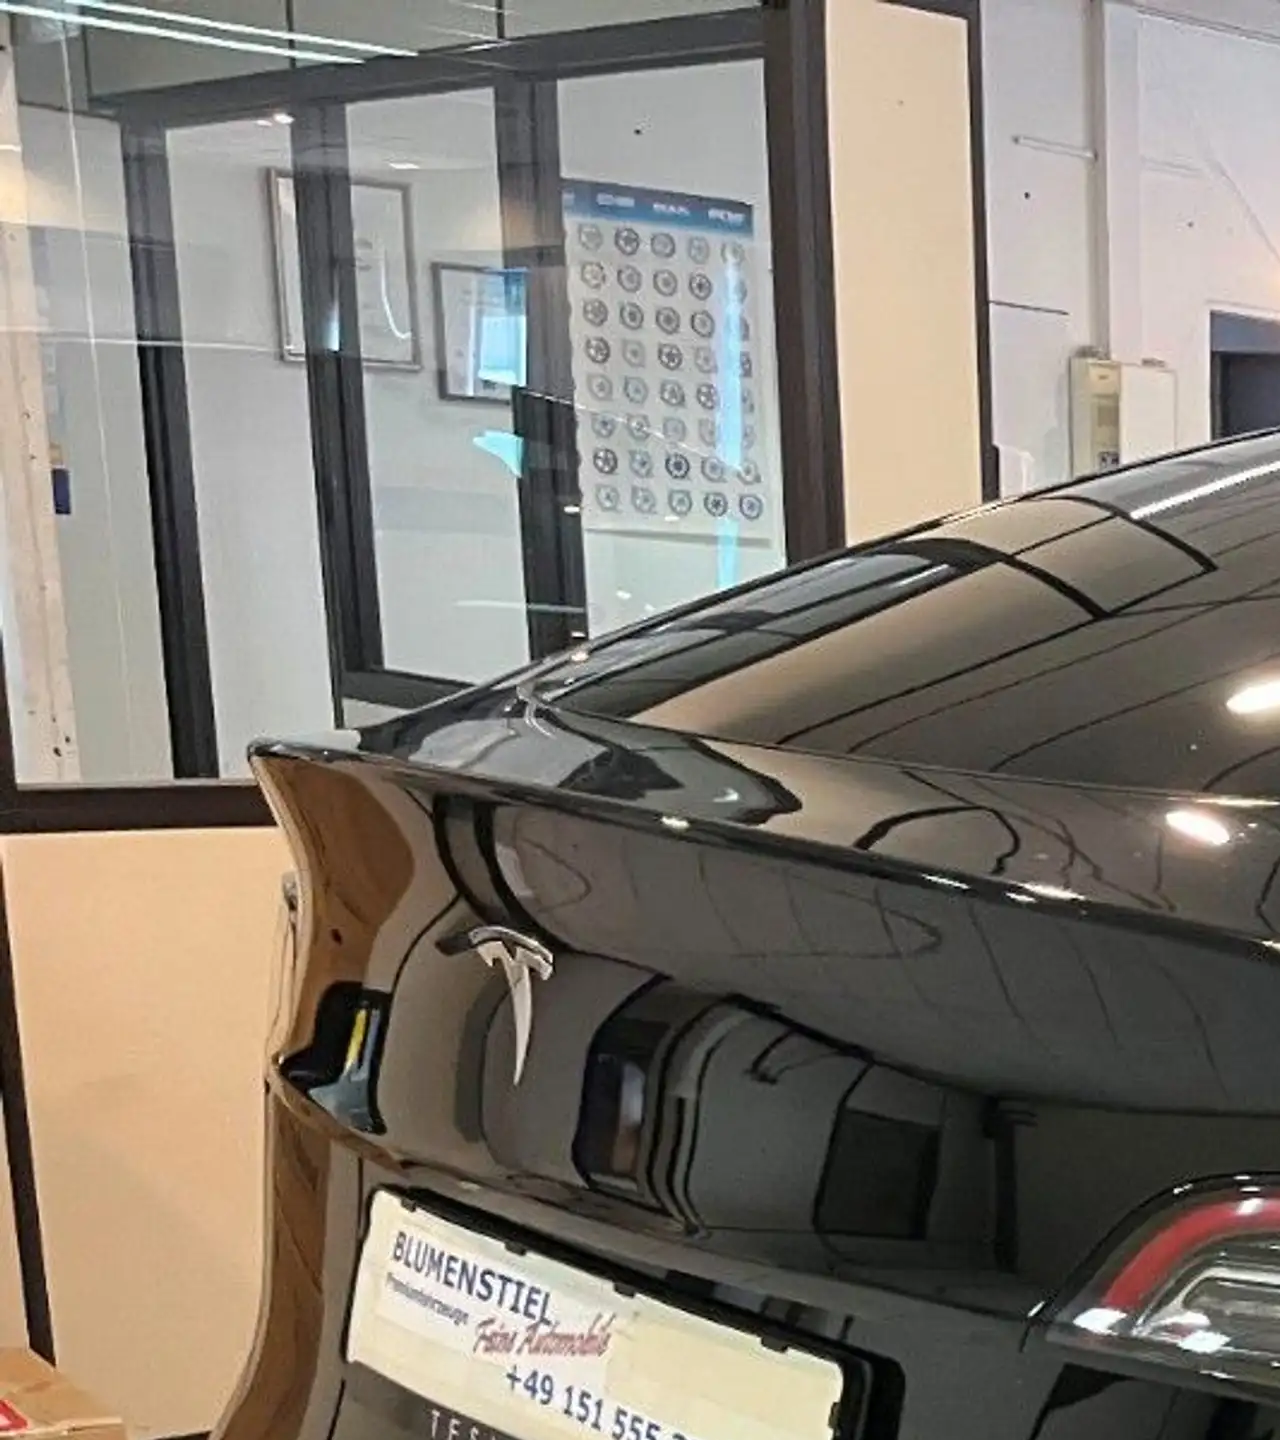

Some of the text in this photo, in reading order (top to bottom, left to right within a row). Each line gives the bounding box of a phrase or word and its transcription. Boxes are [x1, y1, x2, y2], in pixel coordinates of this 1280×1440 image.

[391, 1230, 552, 1326] BLUMENSTIEL
[506, 1364, 554, 1405] +49
[564, 1384, 604, 1432] 151
